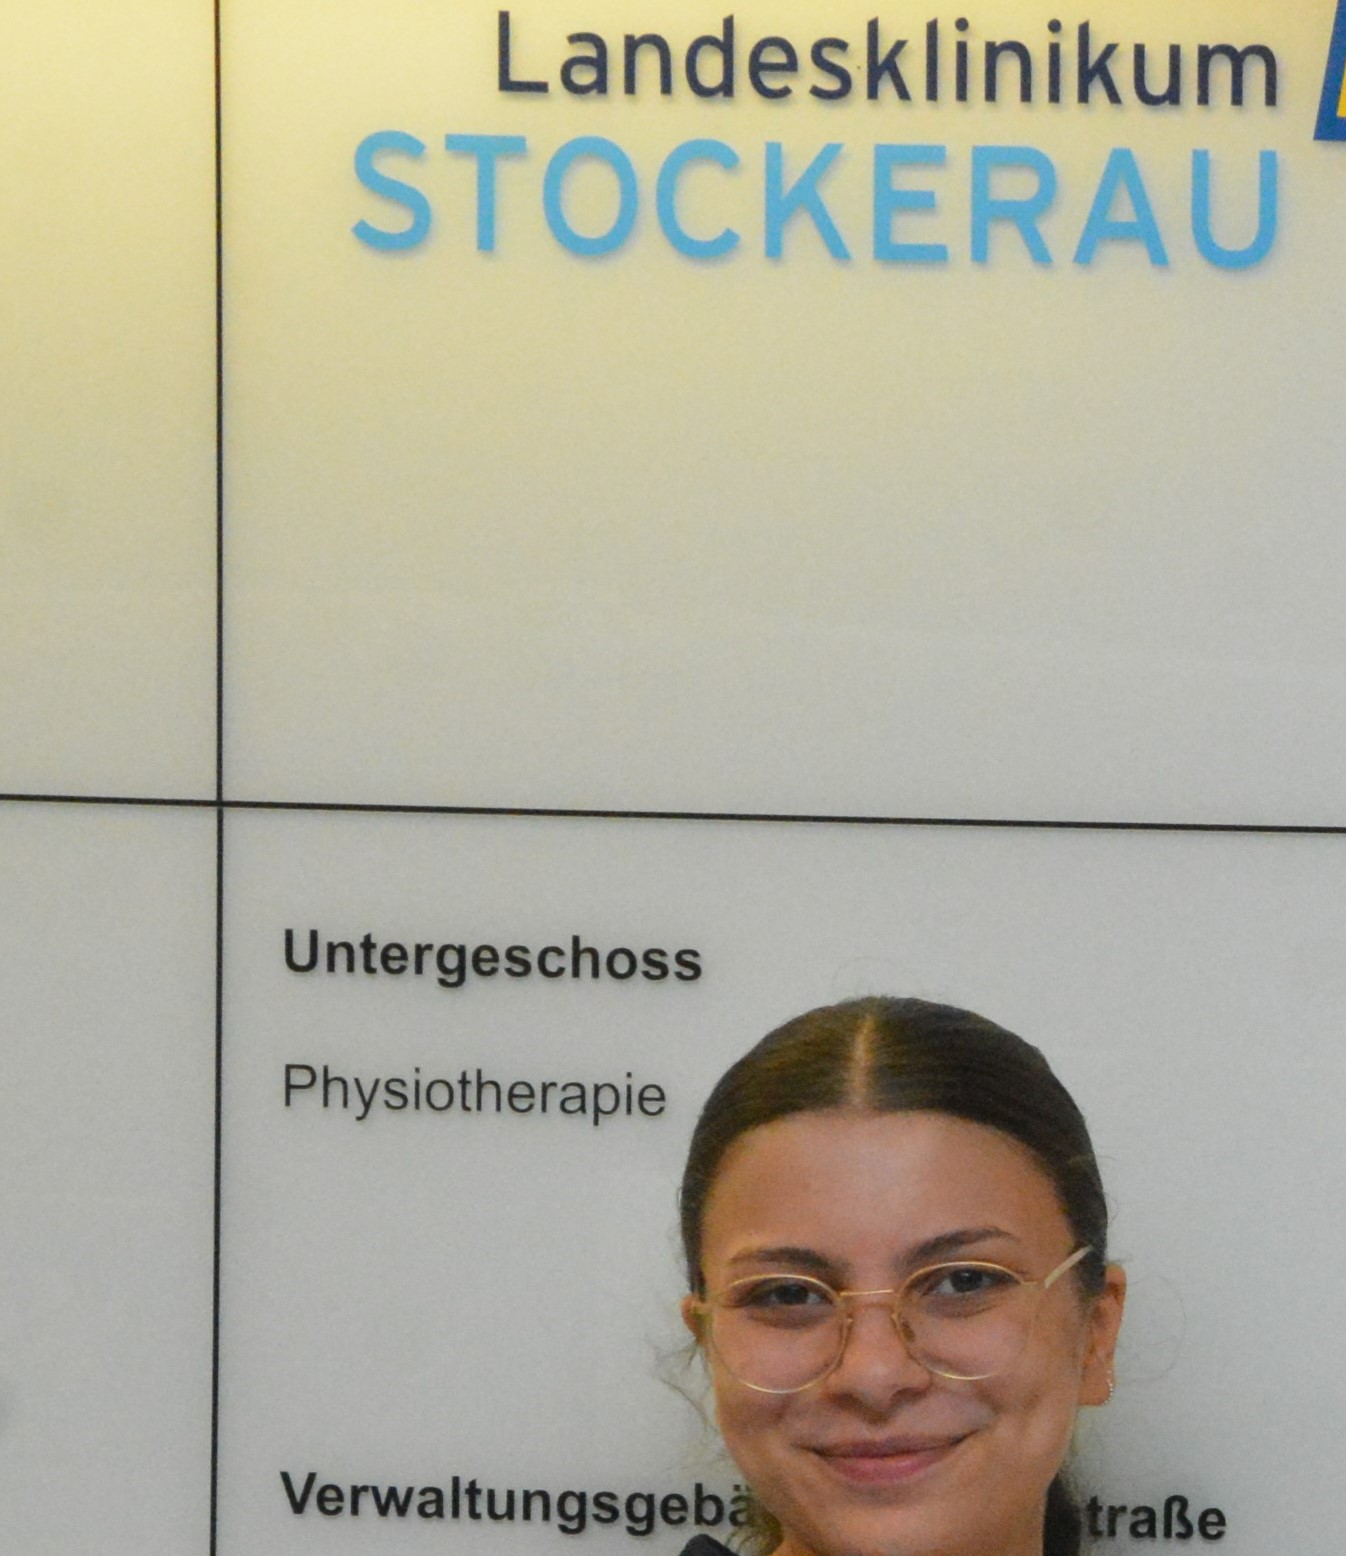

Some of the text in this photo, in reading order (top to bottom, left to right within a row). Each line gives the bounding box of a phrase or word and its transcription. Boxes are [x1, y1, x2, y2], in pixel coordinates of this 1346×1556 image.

[497, 11, 1278, 107] Landesklinikum
[351, 130, 1279, 270] STOCKERAU
[284, 928, 703, 989] Untergeschoss
[284, 1063, 667, 1127] Physiotherapie
